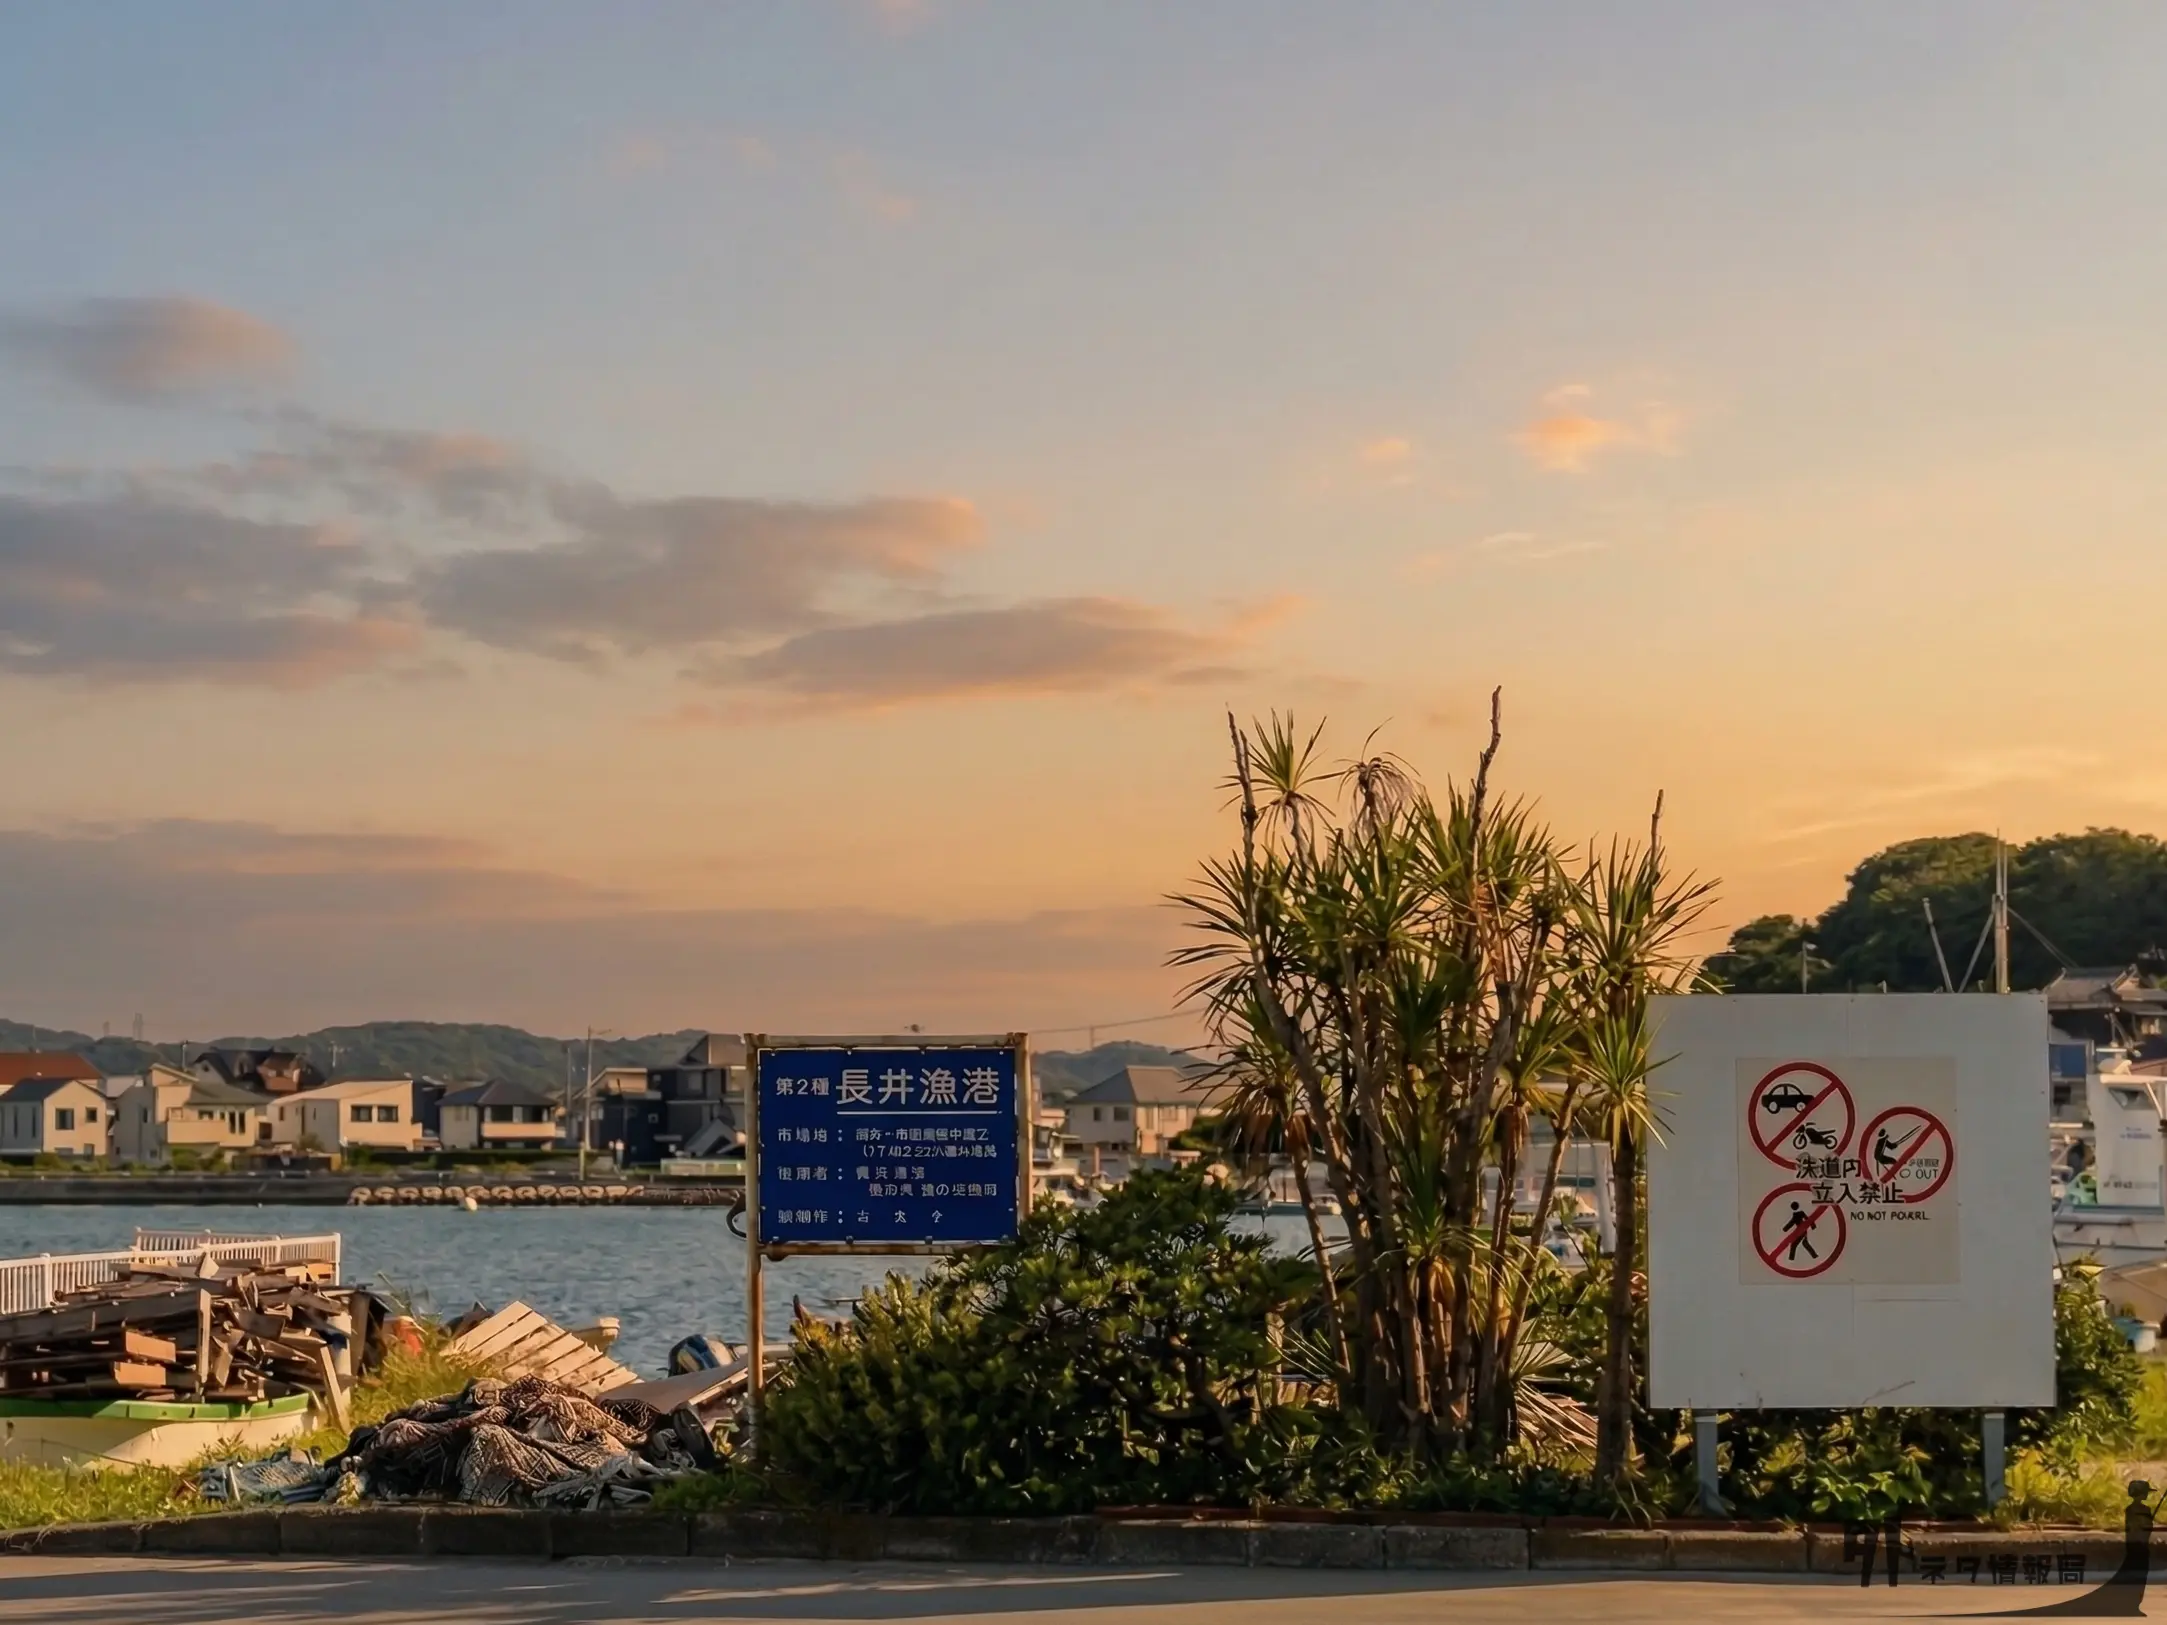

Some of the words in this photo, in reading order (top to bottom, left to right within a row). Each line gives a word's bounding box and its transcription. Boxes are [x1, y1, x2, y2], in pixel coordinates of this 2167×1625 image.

[776, 1077, 830, 1096] 第2種
[836, 1067, 1000, 1105] 長井漁港
[1916, 1169, 1938, 1180] OUT
[1812, 1181, 1904, 1204] 立入禁止
[1850, 1211, 1864, 1221] NO
[1867, 1211, 1886, 1221] NOT
